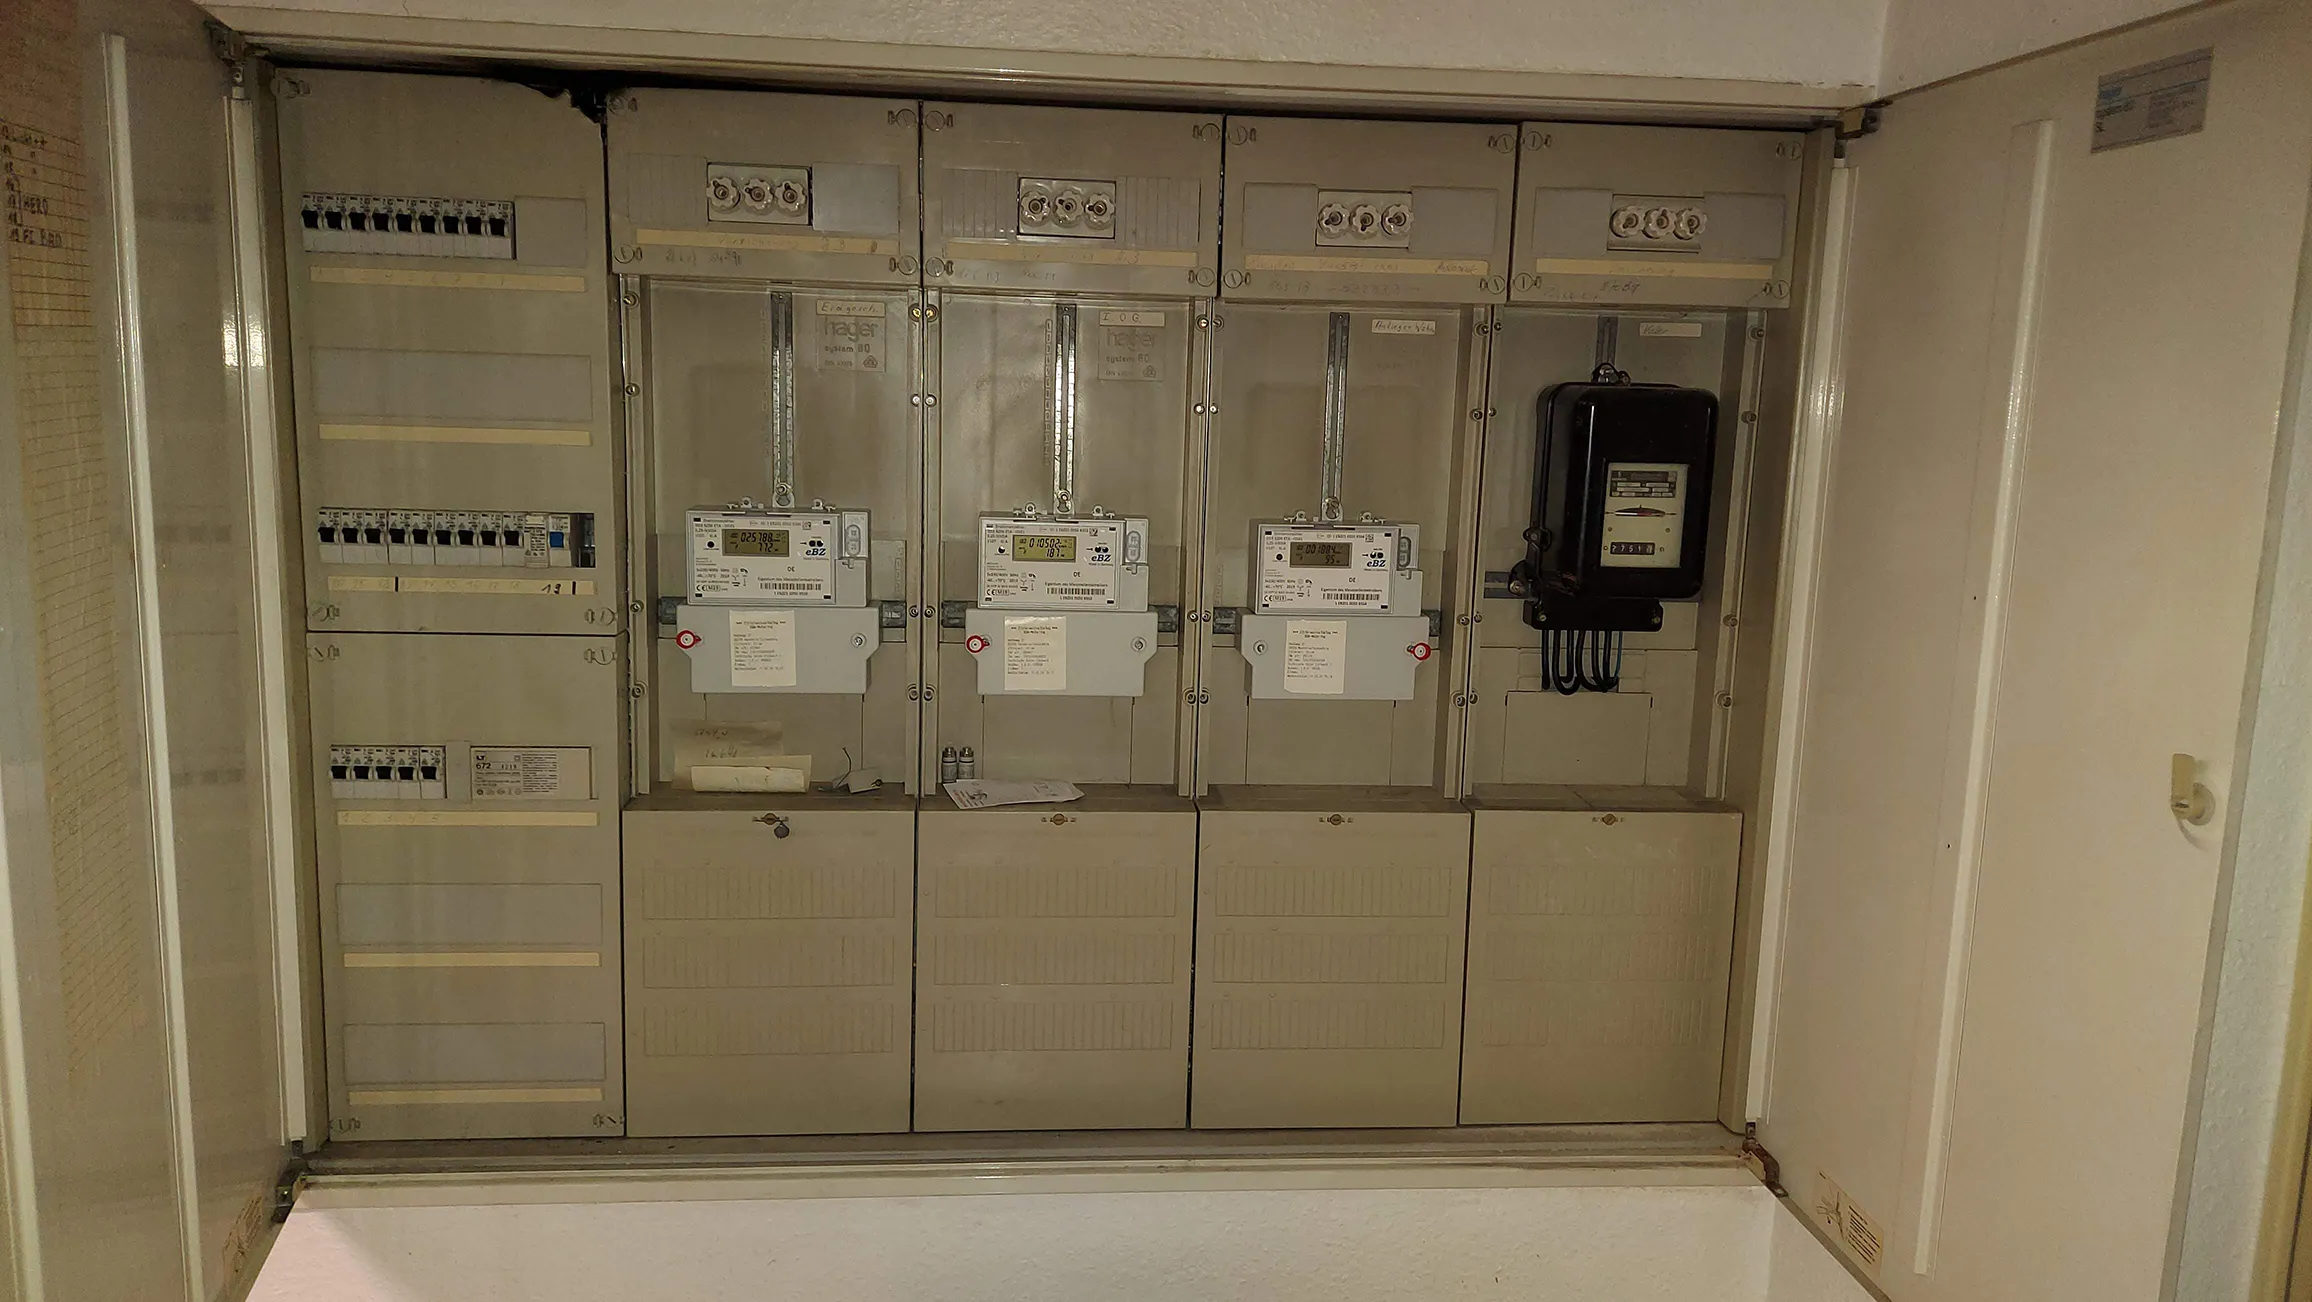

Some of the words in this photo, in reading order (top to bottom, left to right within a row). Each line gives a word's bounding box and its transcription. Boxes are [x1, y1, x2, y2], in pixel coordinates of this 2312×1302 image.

[824, 316, 878, 342] hager
[824, 345, 853, 353] system
[740, 532, 773, 543] 025788
[758, 542, 773, 552] 772
[1029, 538, 1060, 548] 010502
[805, 548, 827, 556] eBZ
[1046, 548, 1060, 558] 187
[1091, 553, 1111, 562] eBZ
[1366, 560, 1387, 568] eBZ
[475, 762, 492, 770] 672
